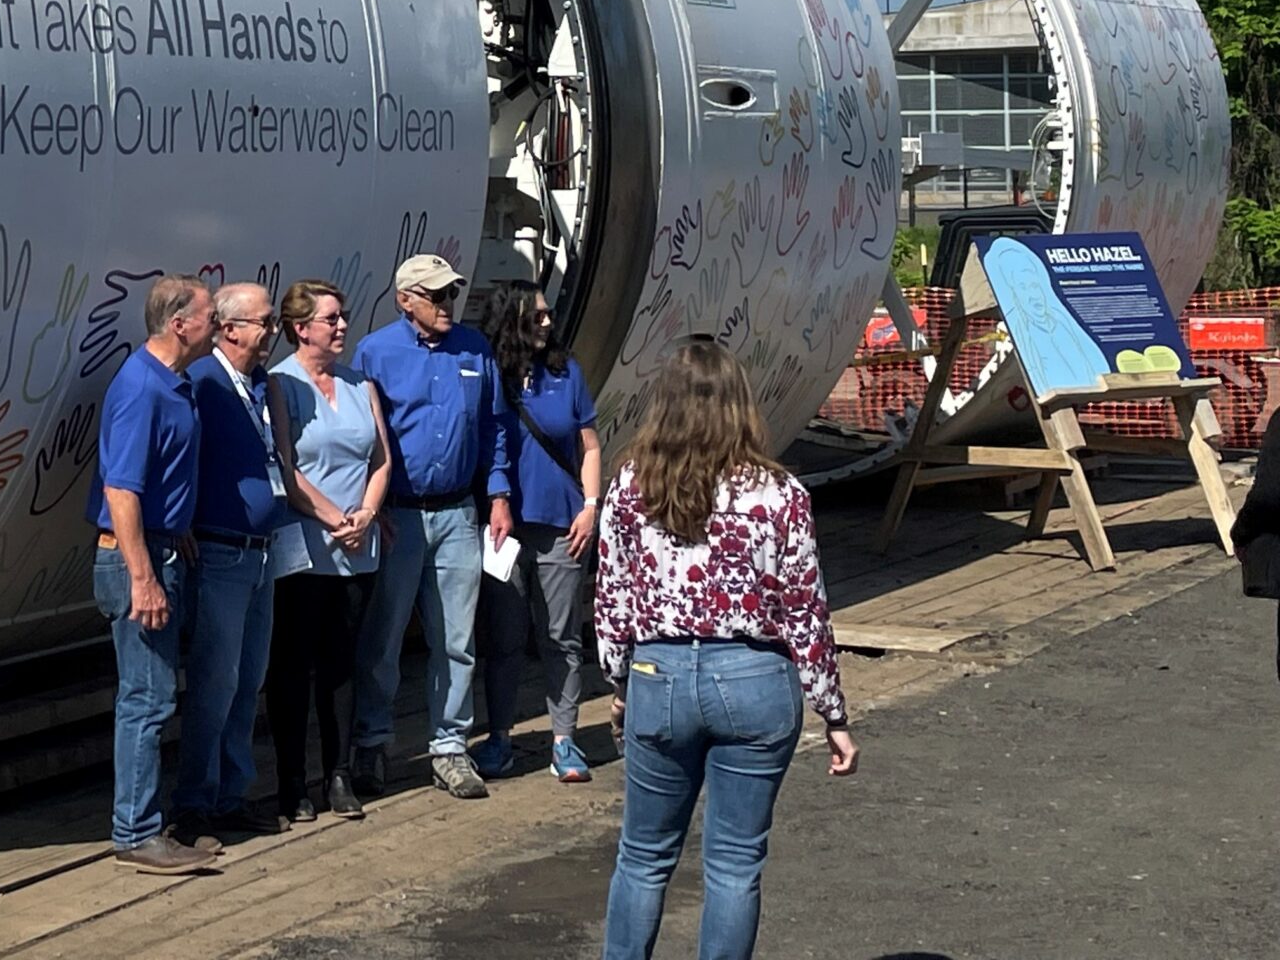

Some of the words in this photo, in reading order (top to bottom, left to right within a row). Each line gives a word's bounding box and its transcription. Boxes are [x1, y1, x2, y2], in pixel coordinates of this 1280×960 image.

[318, 8, 348, 64] to
[1, 85, 103, 171] Keep
[114, 88, 182, 155] Our
[193, 90, 367, 166] Waterways
[377, 94, 455, 152] Clean
[1045, 248, 1091, 264] HELLO
[1092, 246, 1141, 261] HAZEL.
